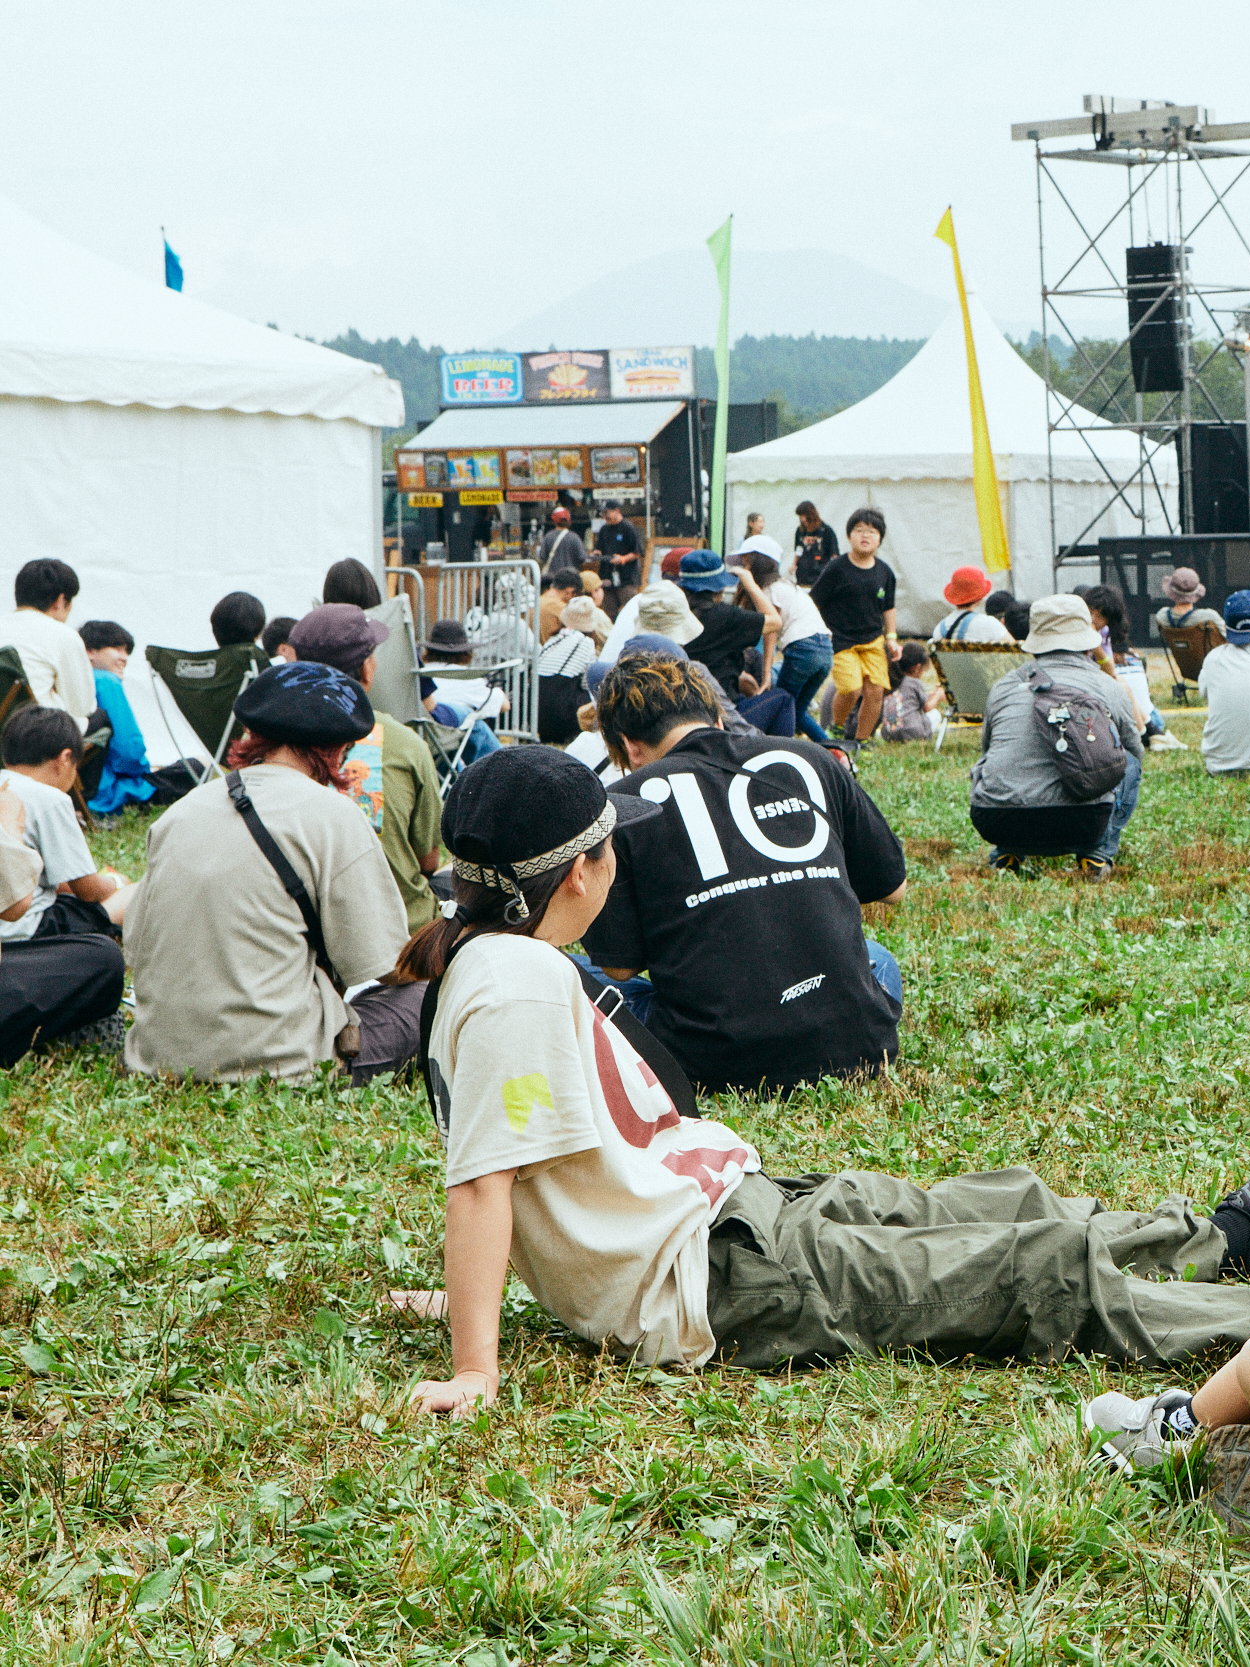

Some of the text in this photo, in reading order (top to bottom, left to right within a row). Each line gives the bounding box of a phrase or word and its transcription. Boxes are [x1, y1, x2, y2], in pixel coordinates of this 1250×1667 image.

[447, 357, 515, 374] LEMONADE
[453, 377, 515, 393] BEER
[754, 797, 810, 820] SENSE
[685, 866, 840, 908] Conquer the field
